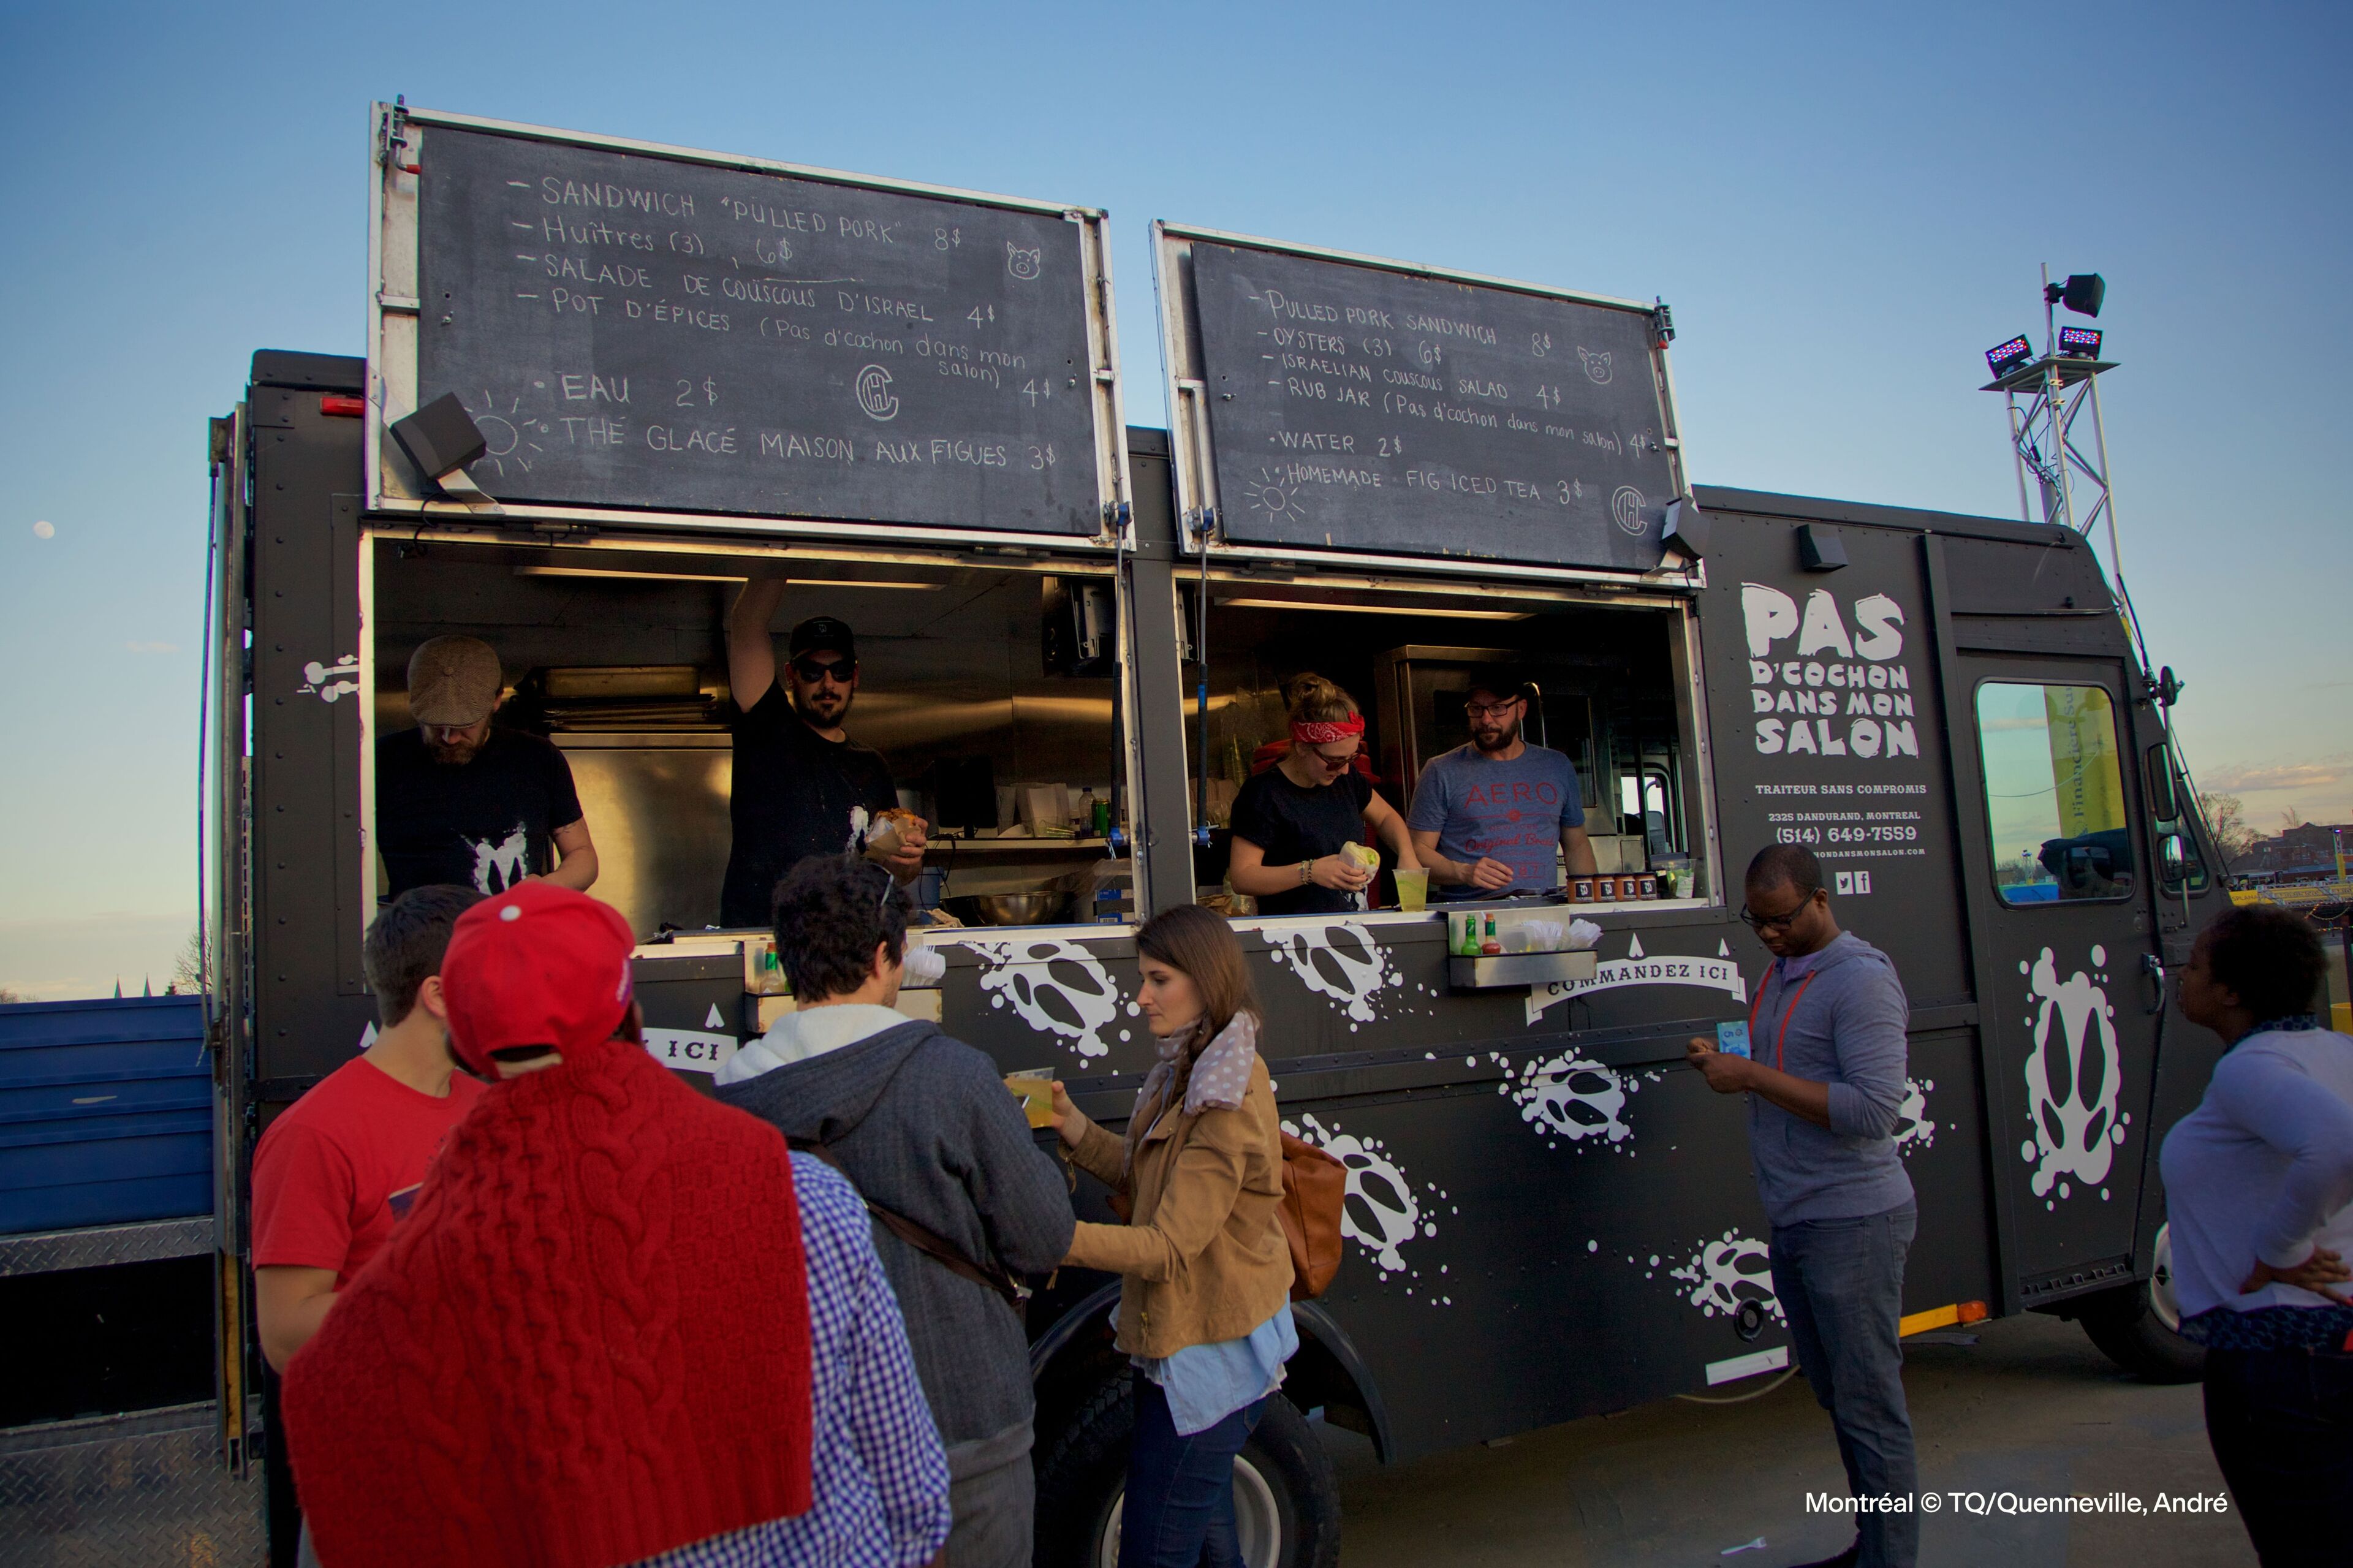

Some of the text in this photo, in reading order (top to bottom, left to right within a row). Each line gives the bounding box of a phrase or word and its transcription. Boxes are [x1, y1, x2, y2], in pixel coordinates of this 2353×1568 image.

[542, 176, 695, 217] SANDWICH
[934, 227, 961, 251] 8$
[543, 215, 792, 263] Huîtres (3) 6$
[544, 254, 653, 288] SALADE
[683, 273, 710, 296] DE
[838, 291, 933, 322] D'ISRAEL
[966, 305, 995, 329] 4$
[553, 288, 604, 314] POT
[760, 317, 811, 340] (Pas
[916, 334, 968, 360] dans
[980, 350, 1025, 369] mon
[1265, 289, 1551, 357] PULLED PORK SANDWICH 8$
[1273, 327, 1441, 365] OYSTERS (3) 6$
[561, 374, 630, 404] EAU
[676, 376, 718, 406] 2$
[939, 360, 1050, 407] salon) 4$
[1282, 352, 1561, 410] ISRAELIAN COUSCOUS SALAD 4$
[1287, 376, 1326, 400] RUB
[1338, 386, 1370, 407] JAR
[1384, 392, 1426, 418] (Pas
[1507, 413, 1538, 433] dans
[1629, 434, 1646, 459] 4$
[559, 416, 626, 445] THÉ
[761, 433, 854, 462] MAISON
[876, 441, 922, 463] AUX
[931, 439, 1007, 466] FIGUES
[1028, 444, 1055, 470] 3$
[1280, 431, 1403, 458] WATER 2$
[1406, 470, 1439, 490] FIG
[1451, 473, 1497, 494] ICED
[1504, 480, 1540, 501] TEA
[1557, 478, 1582, 505] 3$
[1741, 581, 1904, 661] PAS
[1748, 658, 1909, 690] D'COCHON
[1750, 689, 1915, 716] DANS MON
[1756, 718, 1919, 759] SALON
[1464, 782, 1558, 809] AERO
[1755, 784, 1927, 795] TRAITEUR SANS COMPROMIS
[1768, 811, 1920, 822] 2325 DANDURAND, MONTREAL
[1464, 833, 1521, 854] Original
[1776, 826, 1917, 844] (514) 649-7559
[1814, 849, 1925, 858] HONDANSMONSALON.COM
[1700, 964, 1729, 981] ICI
[667, 1040, 719, 1061] ICI
